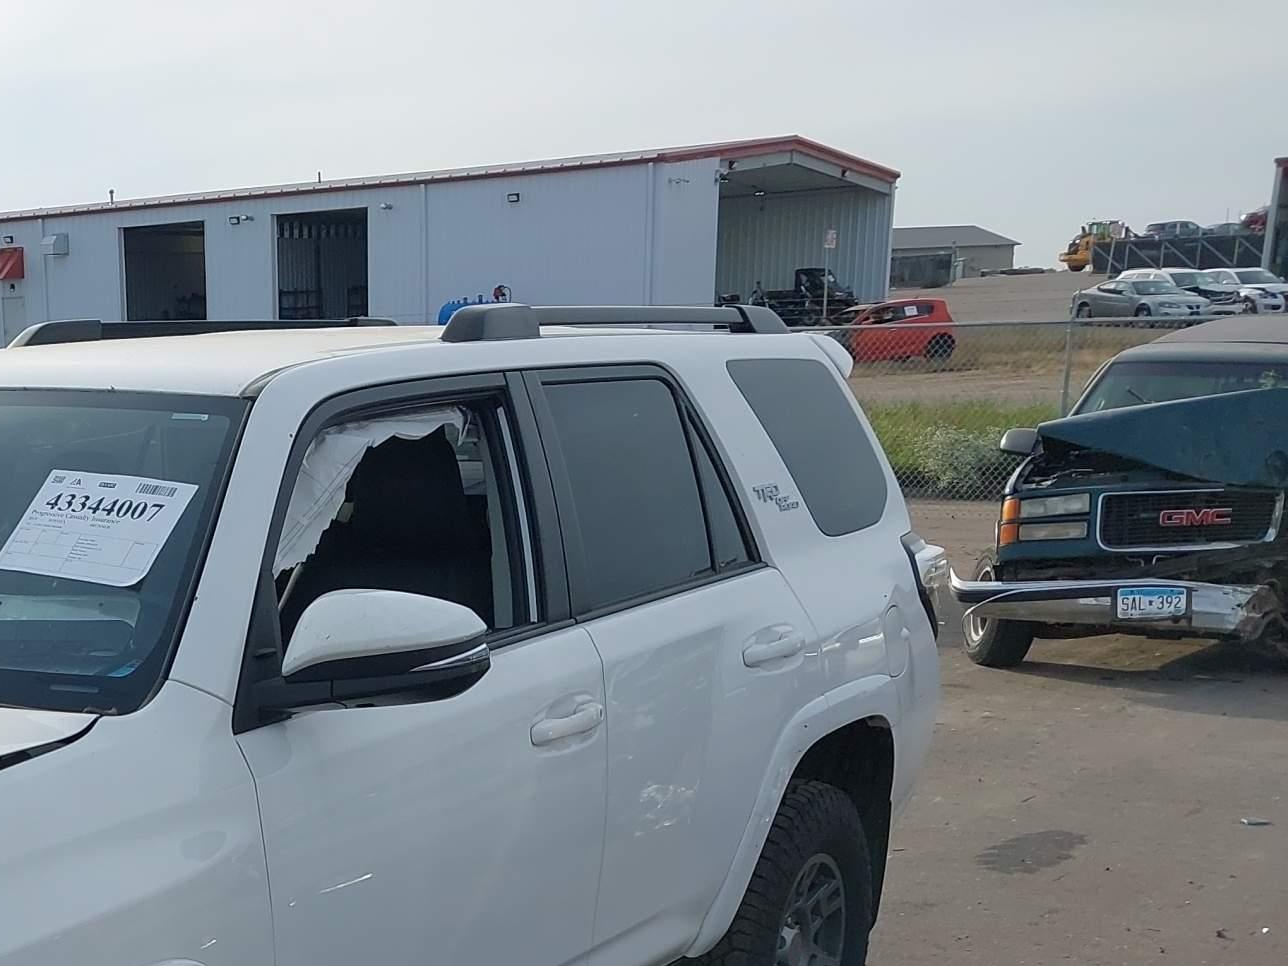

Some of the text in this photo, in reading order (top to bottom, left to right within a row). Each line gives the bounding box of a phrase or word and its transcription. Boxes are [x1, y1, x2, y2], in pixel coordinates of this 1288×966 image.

[46, 493, 165, 521] 43344007
[1160, 508, 1232, 526] GMC
[1121, 596, 1181, 611] SAL 392
